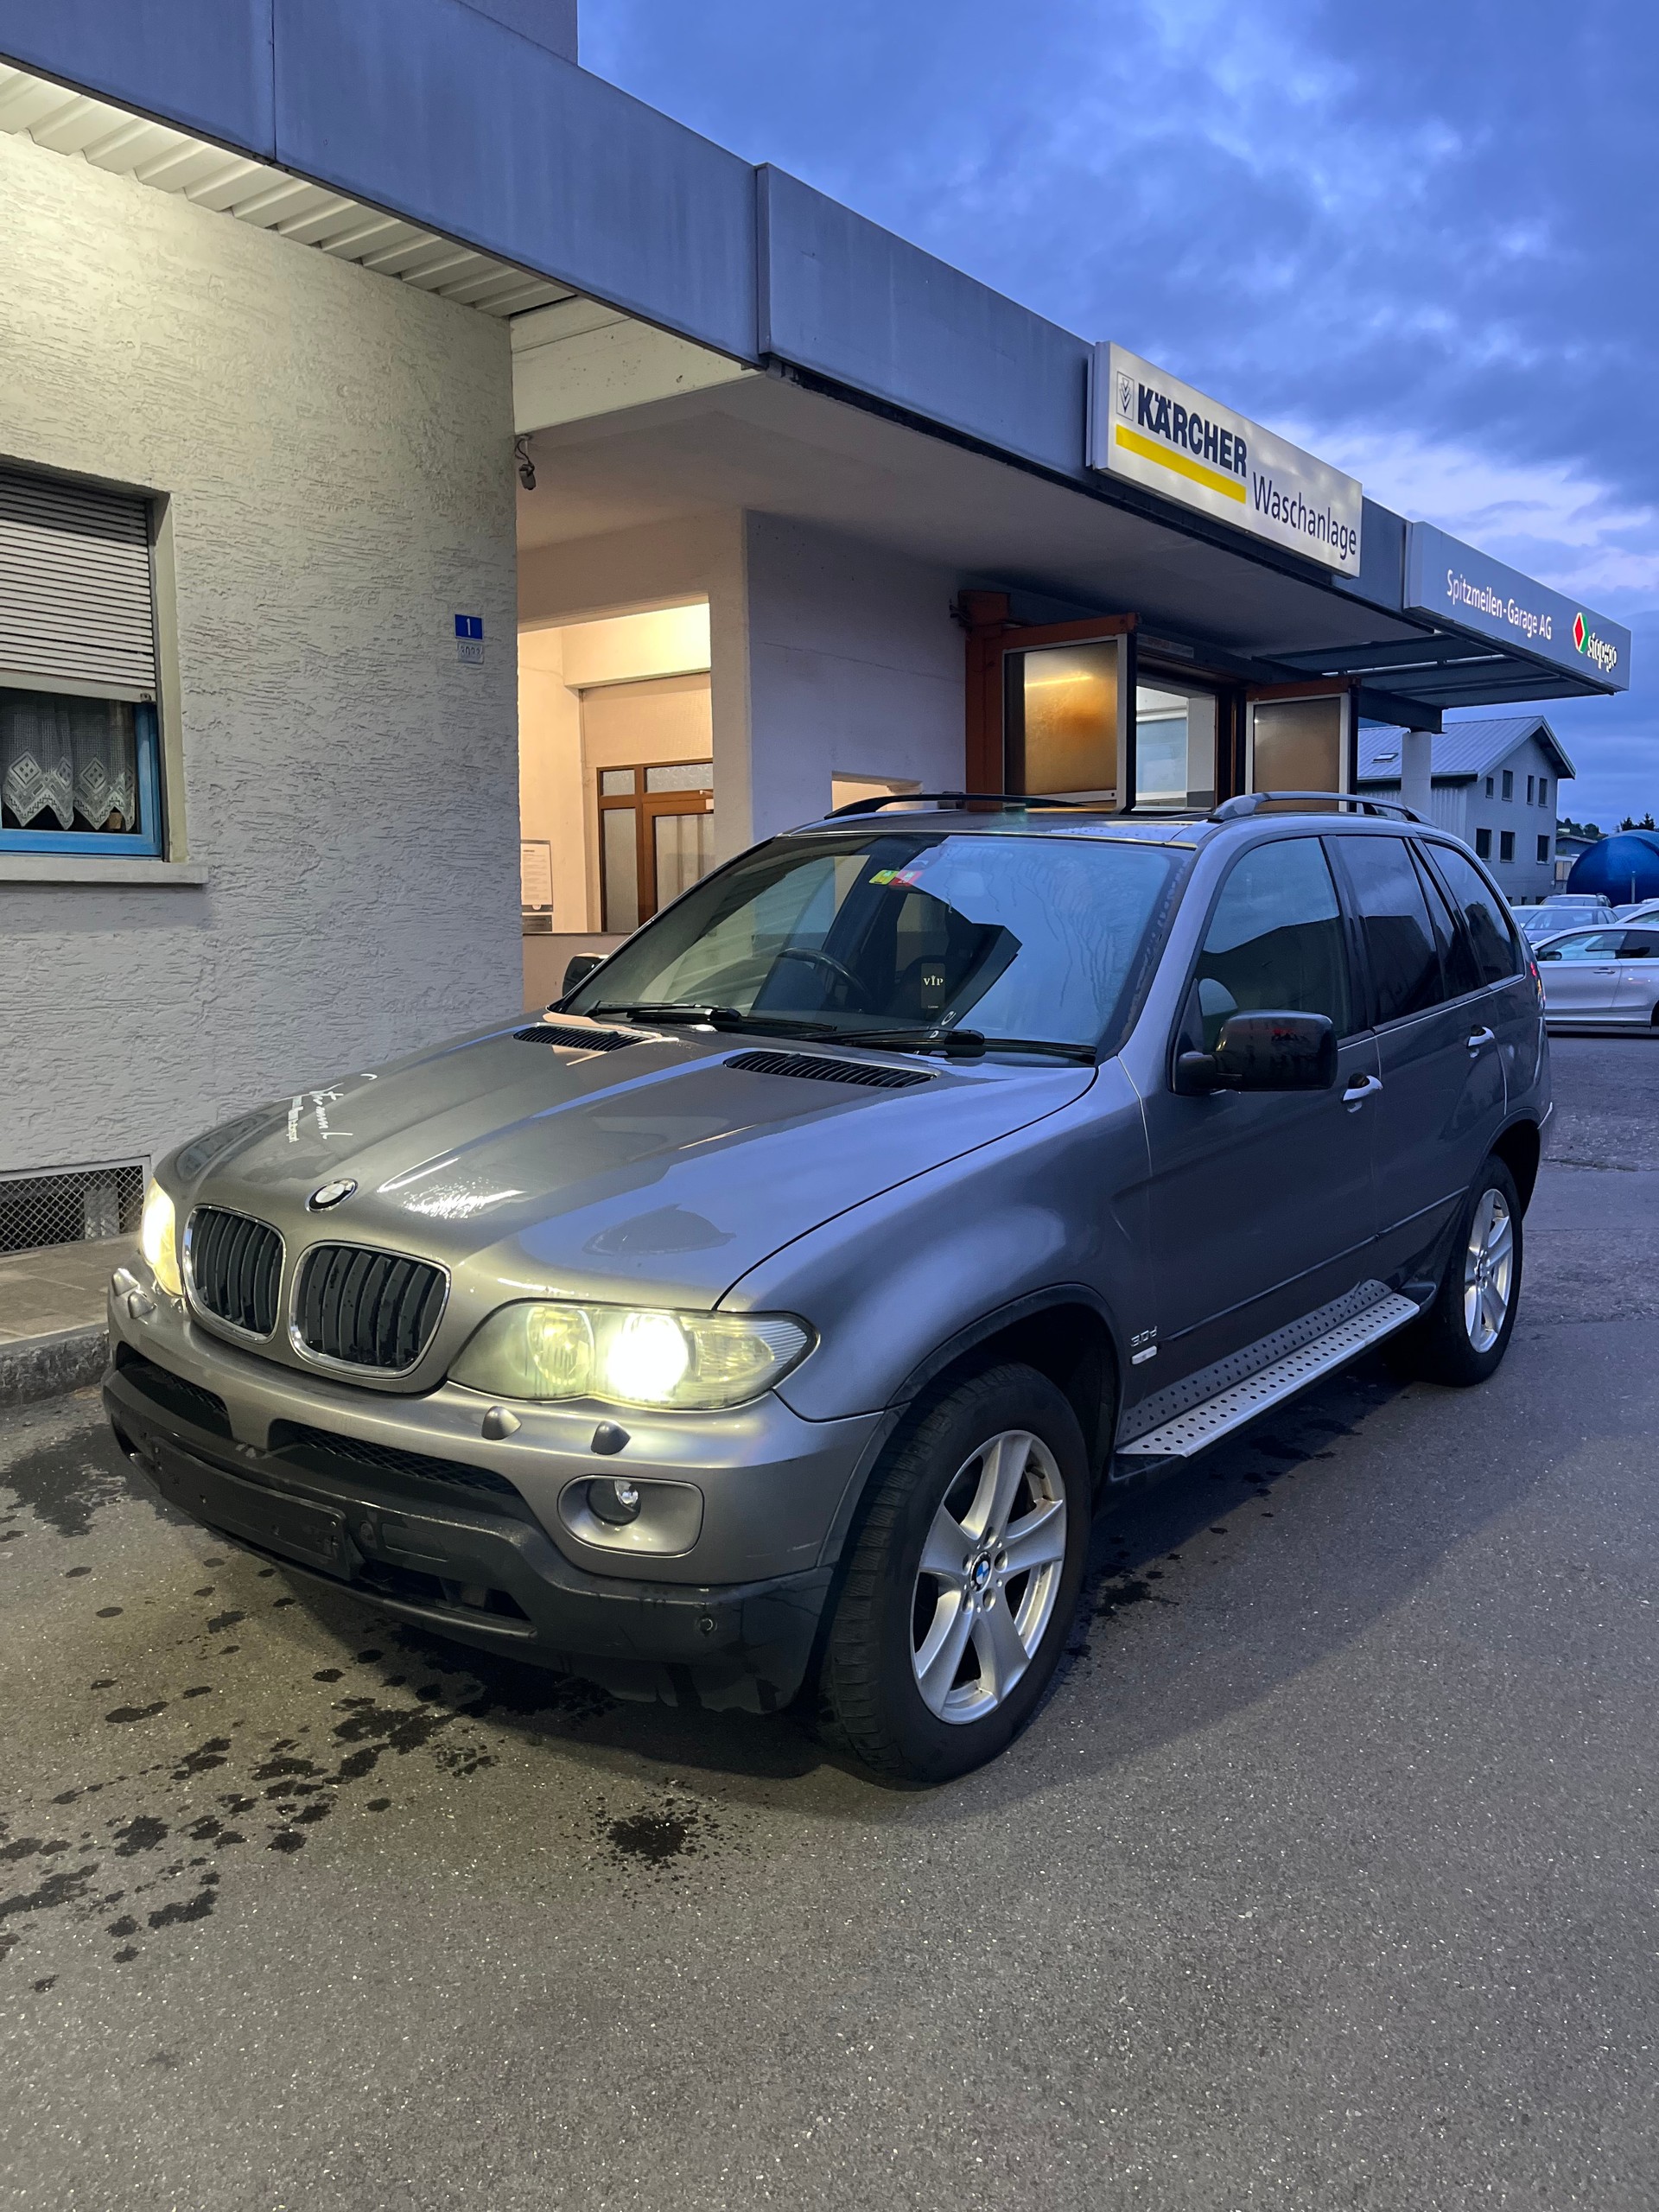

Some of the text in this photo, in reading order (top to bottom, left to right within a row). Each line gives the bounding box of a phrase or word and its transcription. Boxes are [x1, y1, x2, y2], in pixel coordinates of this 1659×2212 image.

[1137, 383, 1248, 478] KÄRCHER
[1253, 472, 1357, 561] Waschanlage
[467, 618, 471, 636] 1
[1446, 569, 1552, 640] Spitzmeilen-Garage AG
